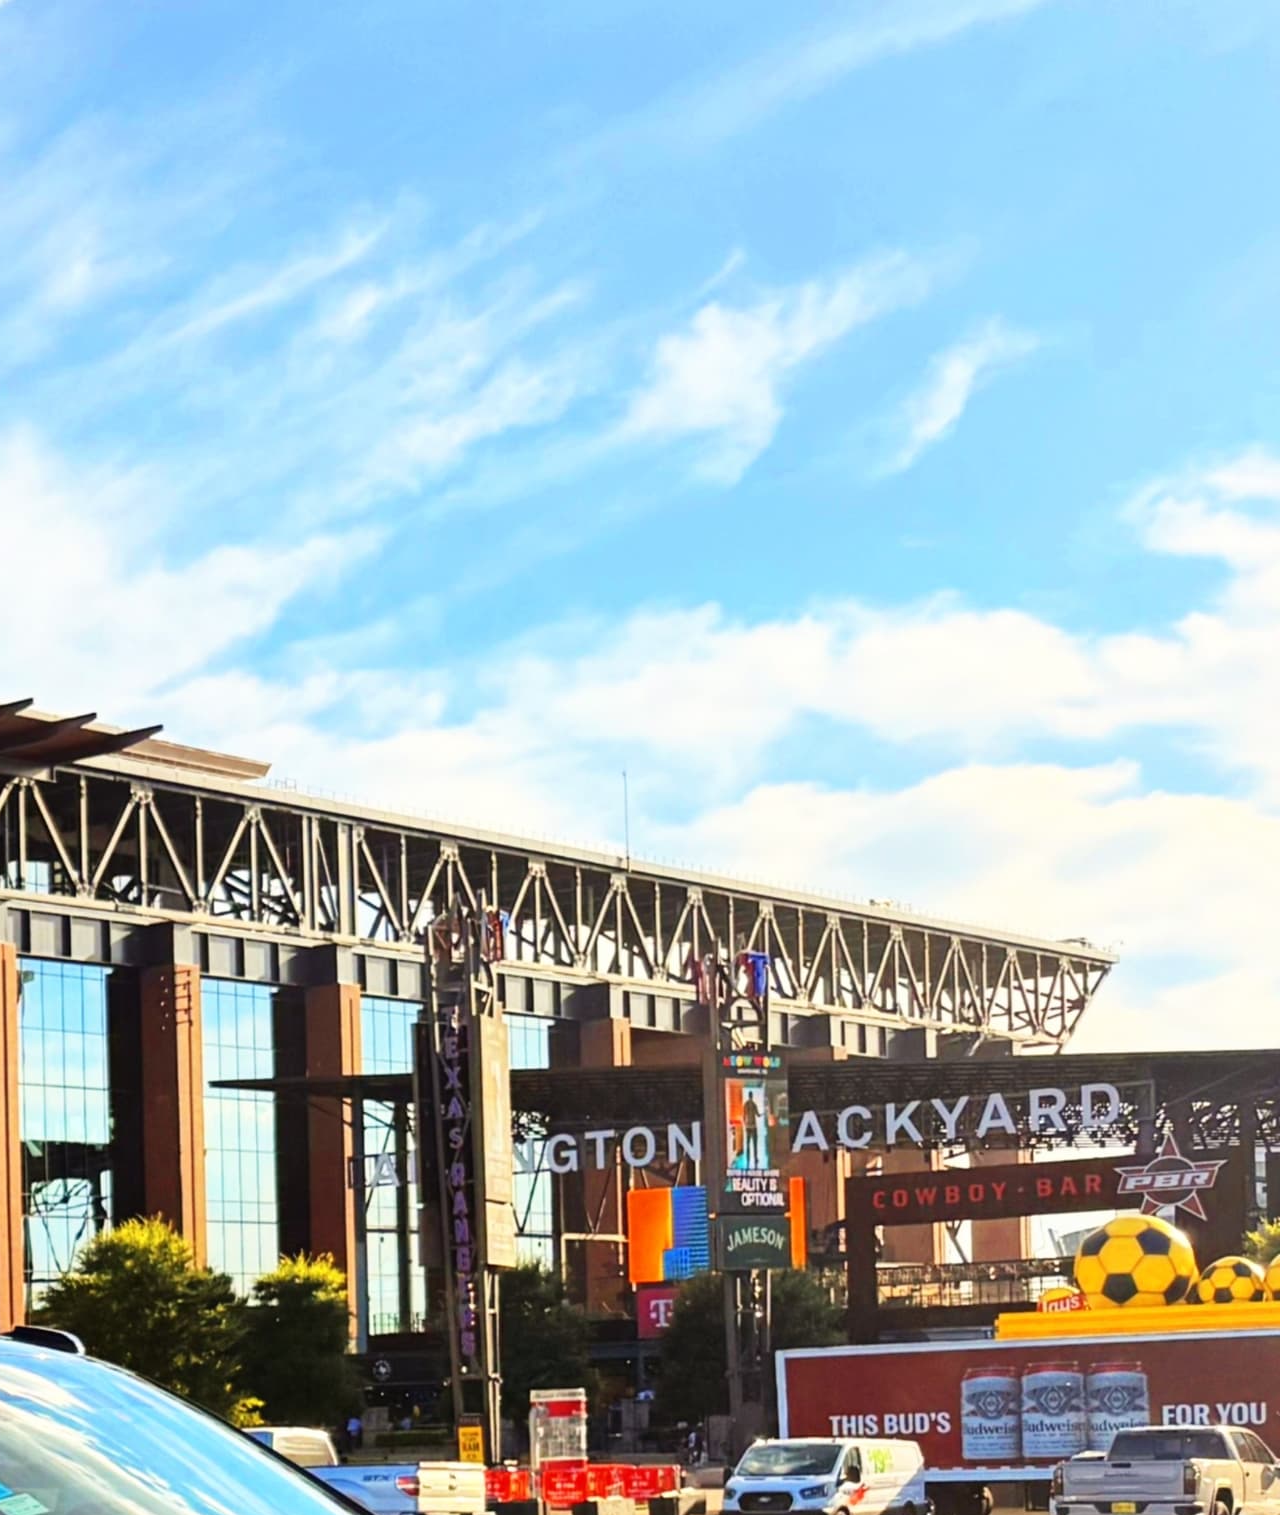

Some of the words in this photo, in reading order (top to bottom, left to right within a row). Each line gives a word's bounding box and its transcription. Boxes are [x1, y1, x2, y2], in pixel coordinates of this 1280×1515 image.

[791, 1082, 1121, 1154] ACKYARD
[872, 1181, 1007, 1209] COWBOY
[1036, 1173, 1103, 1198] BAR
[1124, 1171, 1210, 1191] PBR
[726, 1226, 785, 1252] JAMESON
[828, 1414, 879, 1436] THIS
[883, 1411, 951, 1435] BUD'S
[1161, 1404, 1210, 1426] FOR
[1215, 1401, 1267, 1425] YOU
